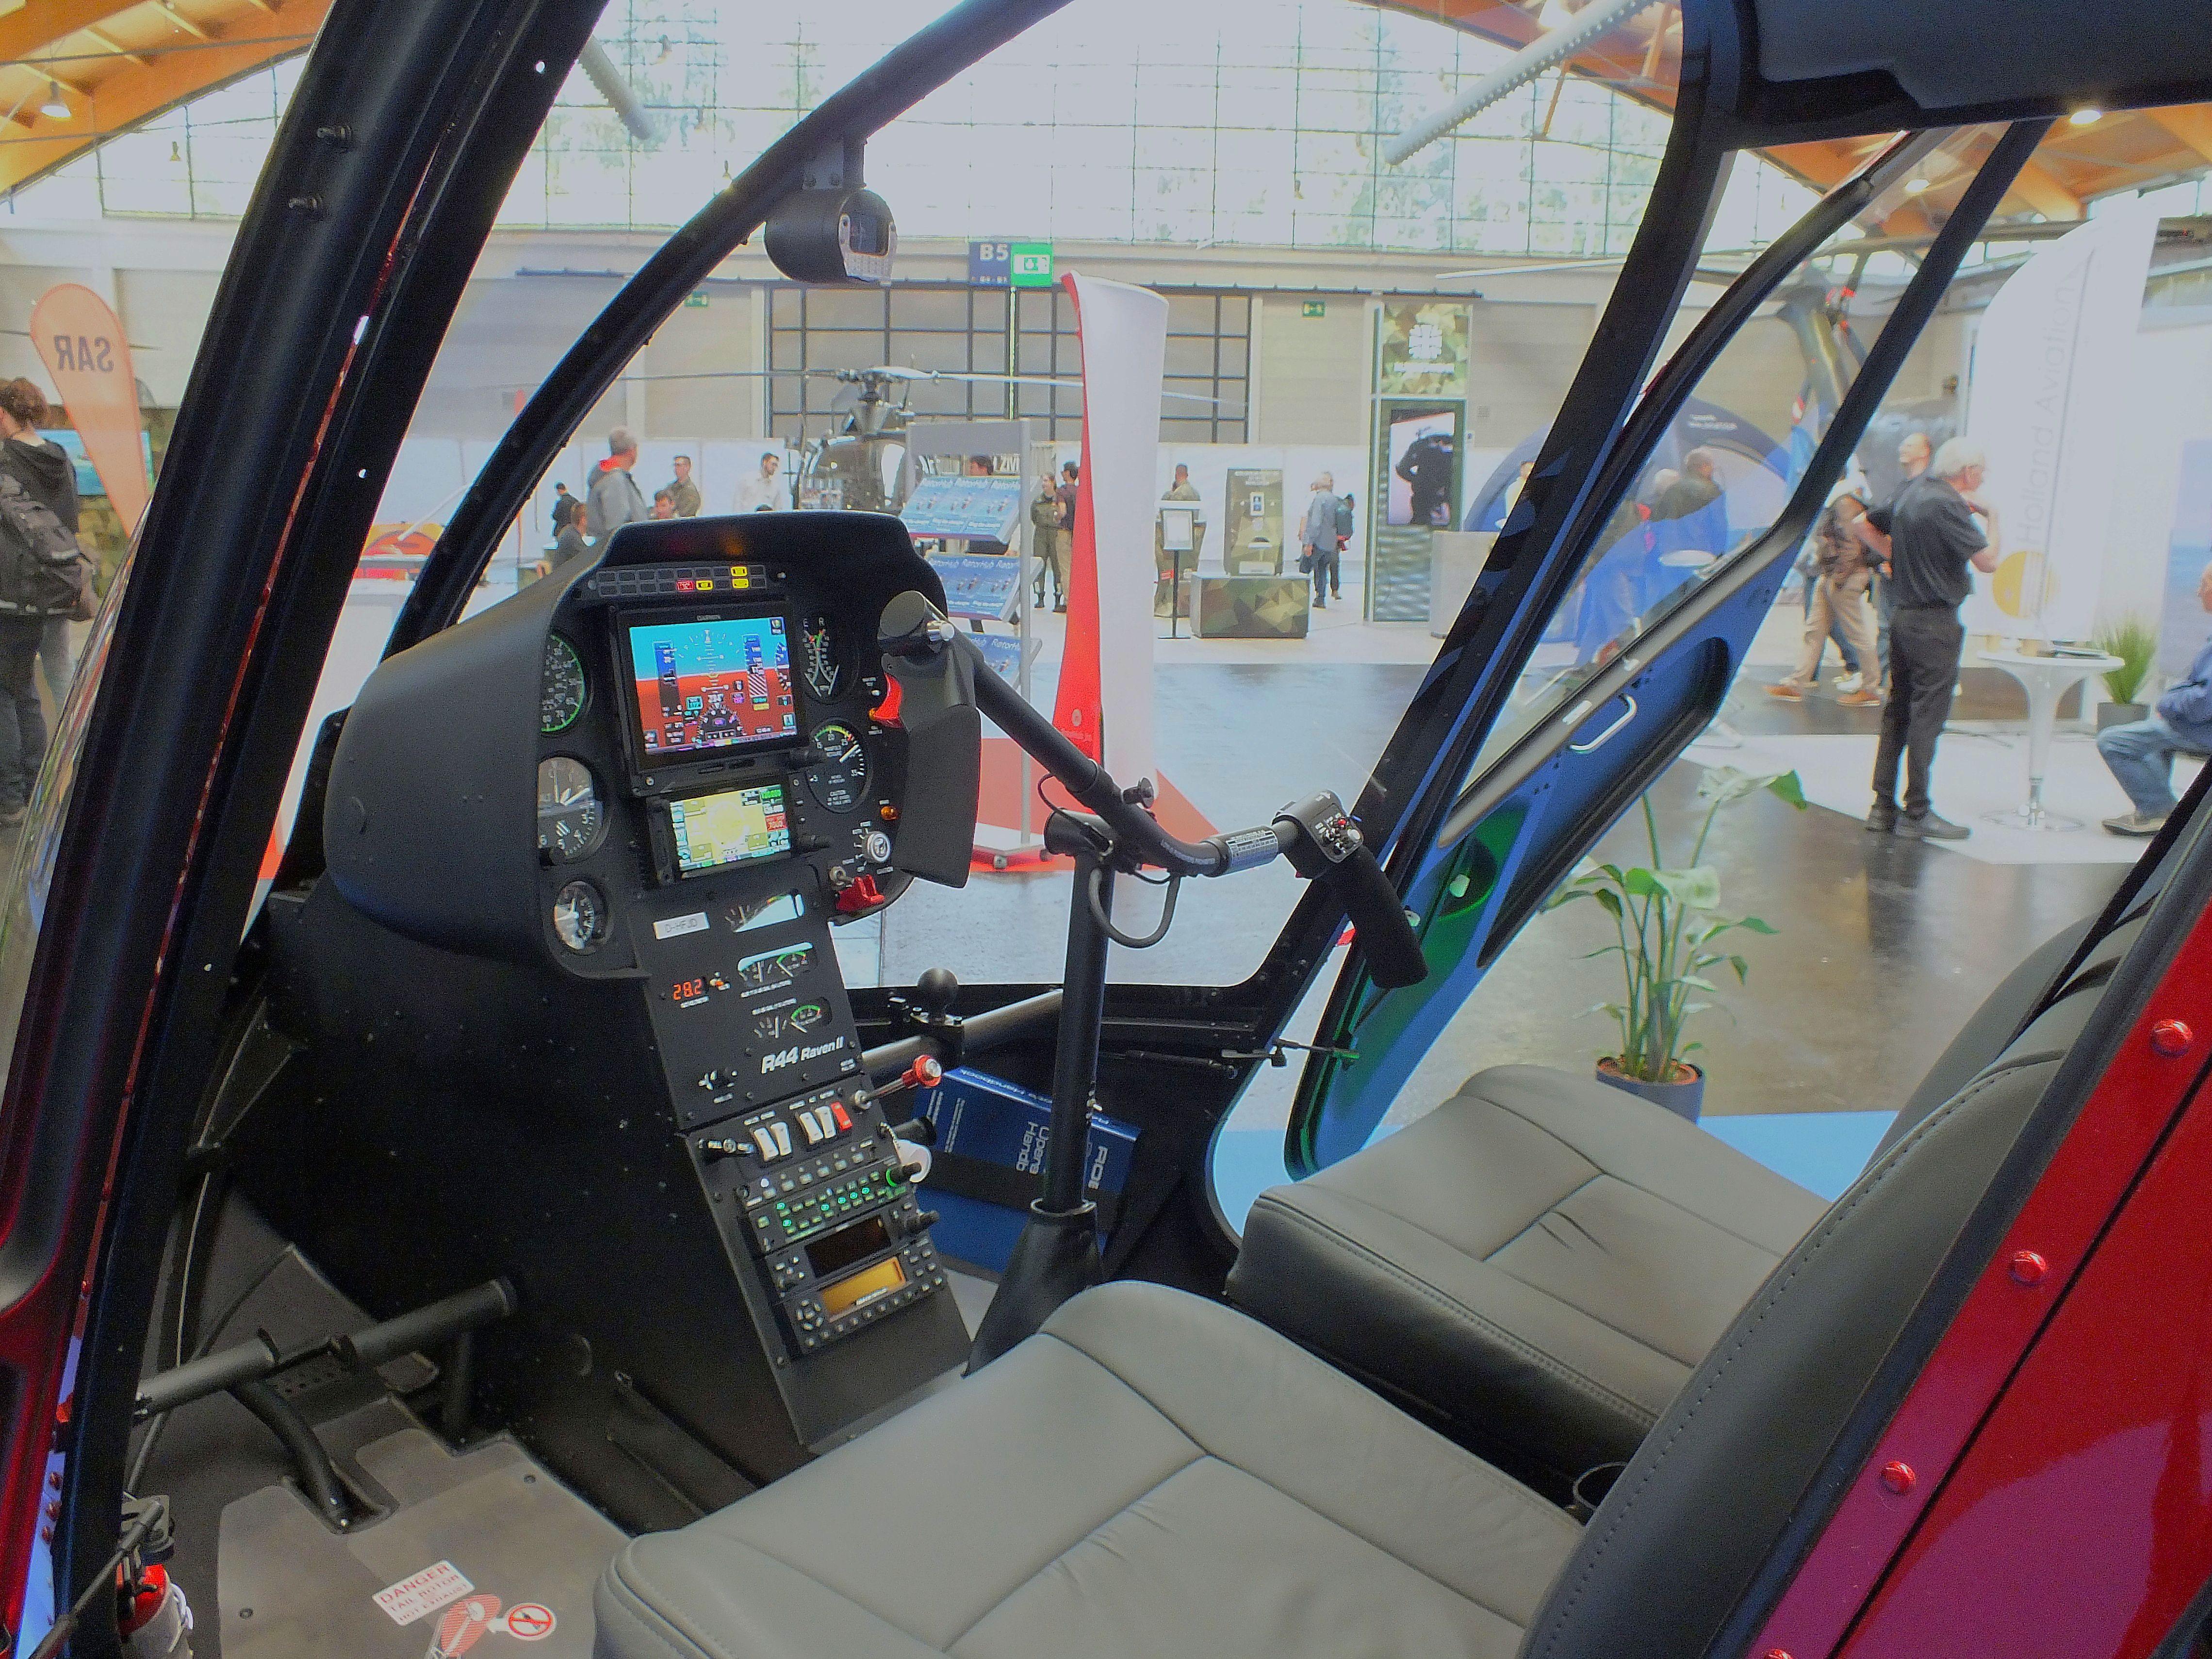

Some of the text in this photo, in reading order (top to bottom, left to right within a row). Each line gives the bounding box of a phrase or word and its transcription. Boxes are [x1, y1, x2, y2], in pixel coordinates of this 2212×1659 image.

[980, 244, 1009, 261] B5
[2034, 284, 2075, 416] Aviation
[2016, 425, 2053, 546] Holland
[761, 1035, 845, 1074] R44 Raven II
[380, 1565, 450, 1604] DANGER
